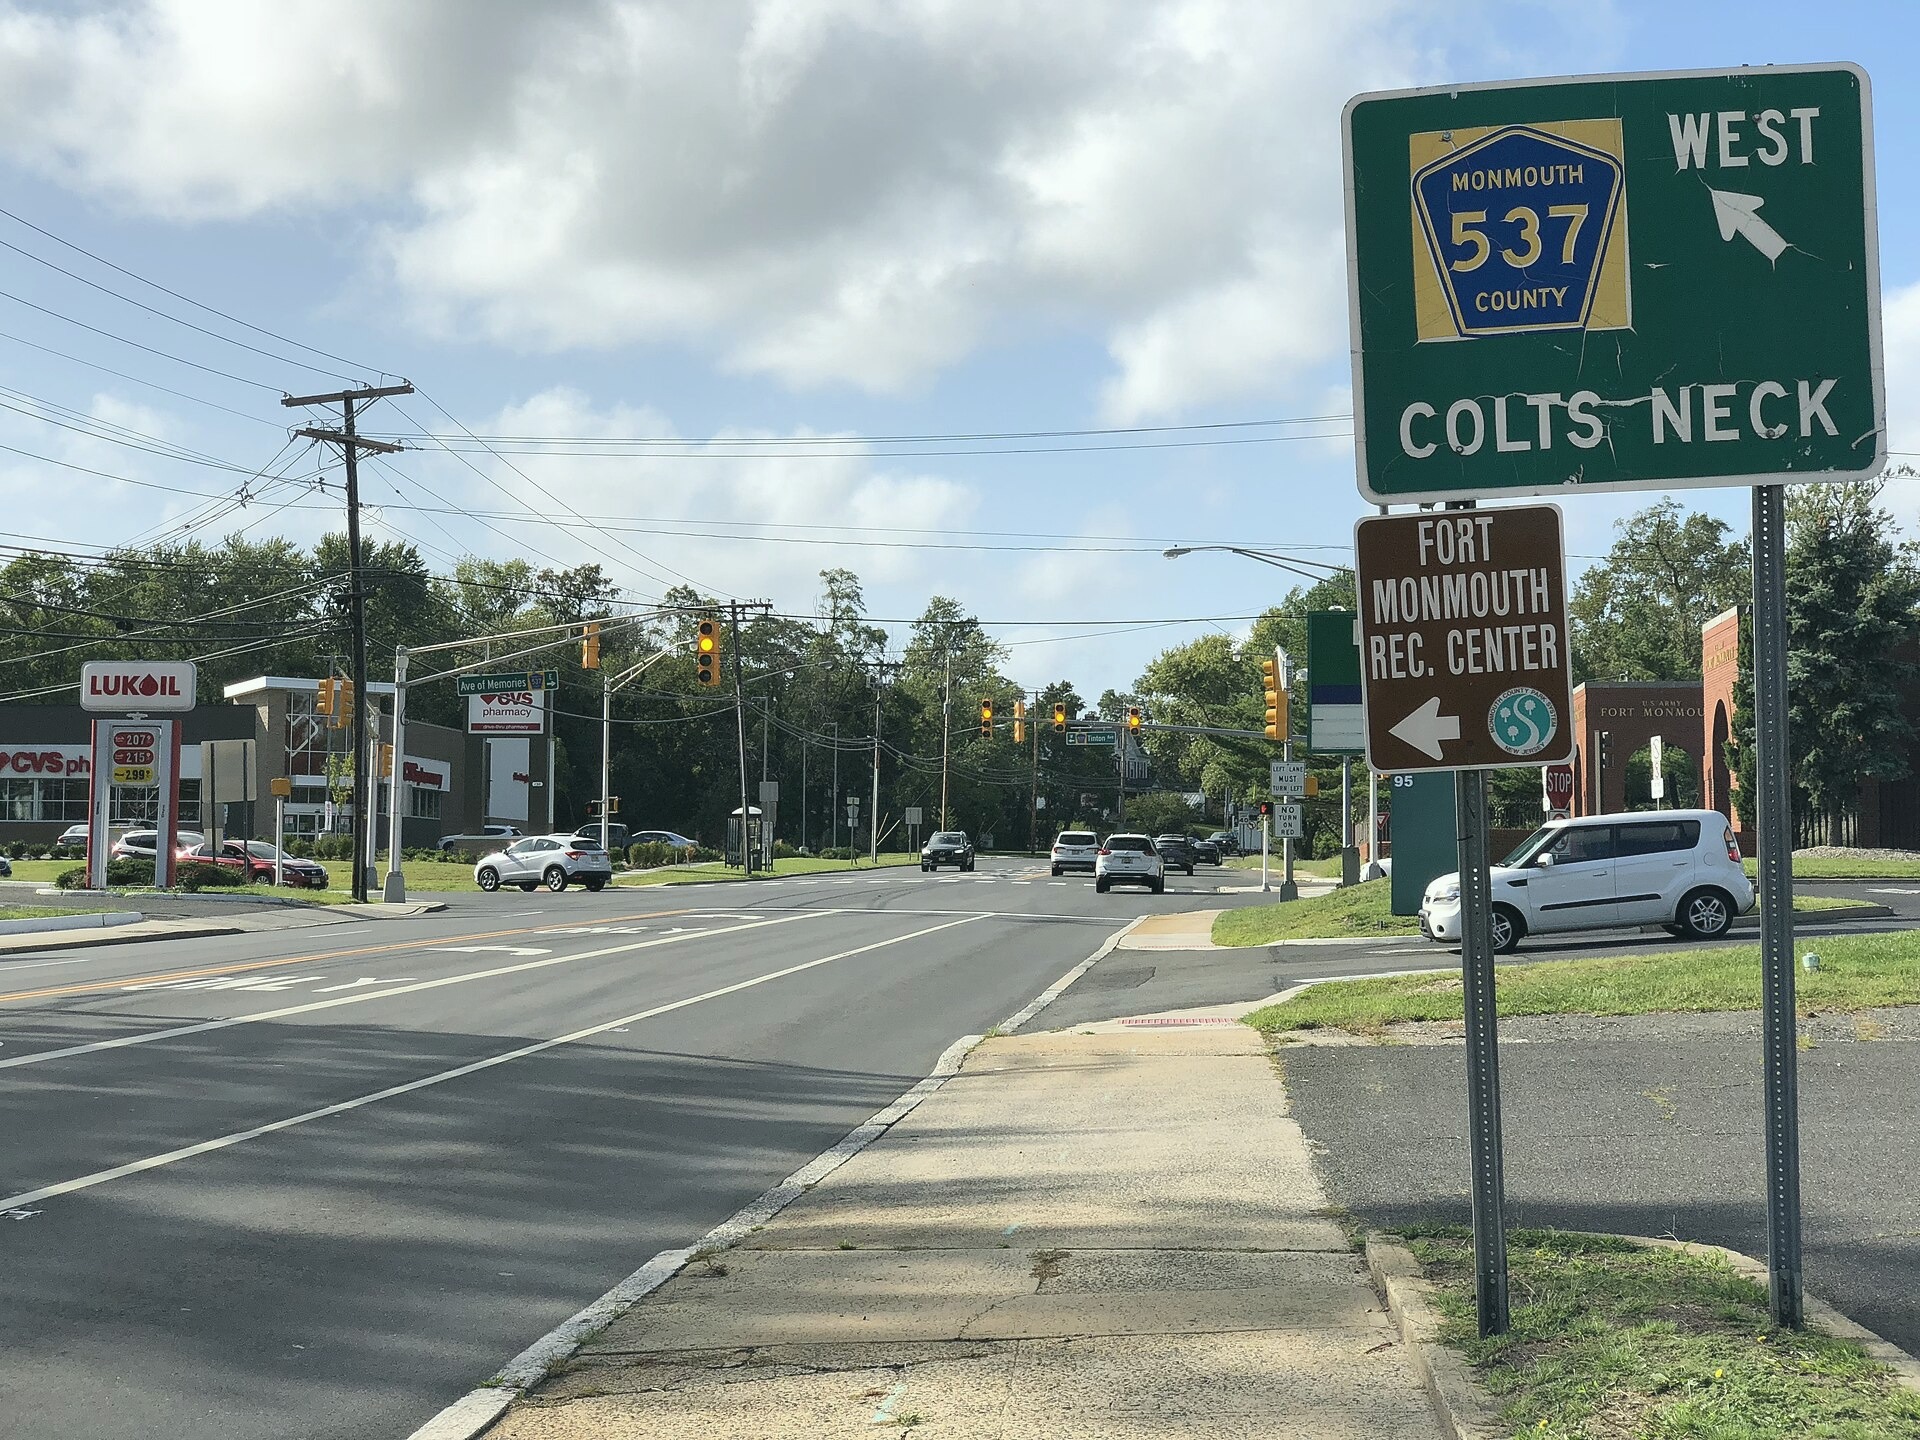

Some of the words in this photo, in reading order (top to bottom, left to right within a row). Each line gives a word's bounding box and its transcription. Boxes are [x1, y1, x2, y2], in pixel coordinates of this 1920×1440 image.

[1666, 107, 1821, 171] WEST
[1452, 164, 1584, 192] MONMOUTH
[1450, 203, 1590, 272] 537
[1475, 286, 1568, 312] COUNTY
[1399, 390, 1604, 459] COLTS
[1651, 378, 1840, 445] NECK
[1418, 516, 1494, 566] FORT
[1372, 567, 1550, 625] MONMOUTH
[1370, 632, 1434, 680] REC.
[1447, 623, 1558, 675] CENTER
[460, 681, 475, 691] Ave
[478, 679, 485, 690] of
[487, 678, 527, 690] Memories
[1502, 688, 1530, 699] COUNTY
[1530, 689, 1547, 703] PARK
[497, 692, 533, 706] CVS
[482, 708, 532, 717] pharmacy
[1601, 707, 1635, 717] FORT
[1504, 745, 1520, 754] NEW
[1521, 742, 1546, 755] JERSEY
[11, 751, 64, 773] CVS
[1394, 776, 1413, 787] 95
[1548, 772, 1571, 792] STOP
